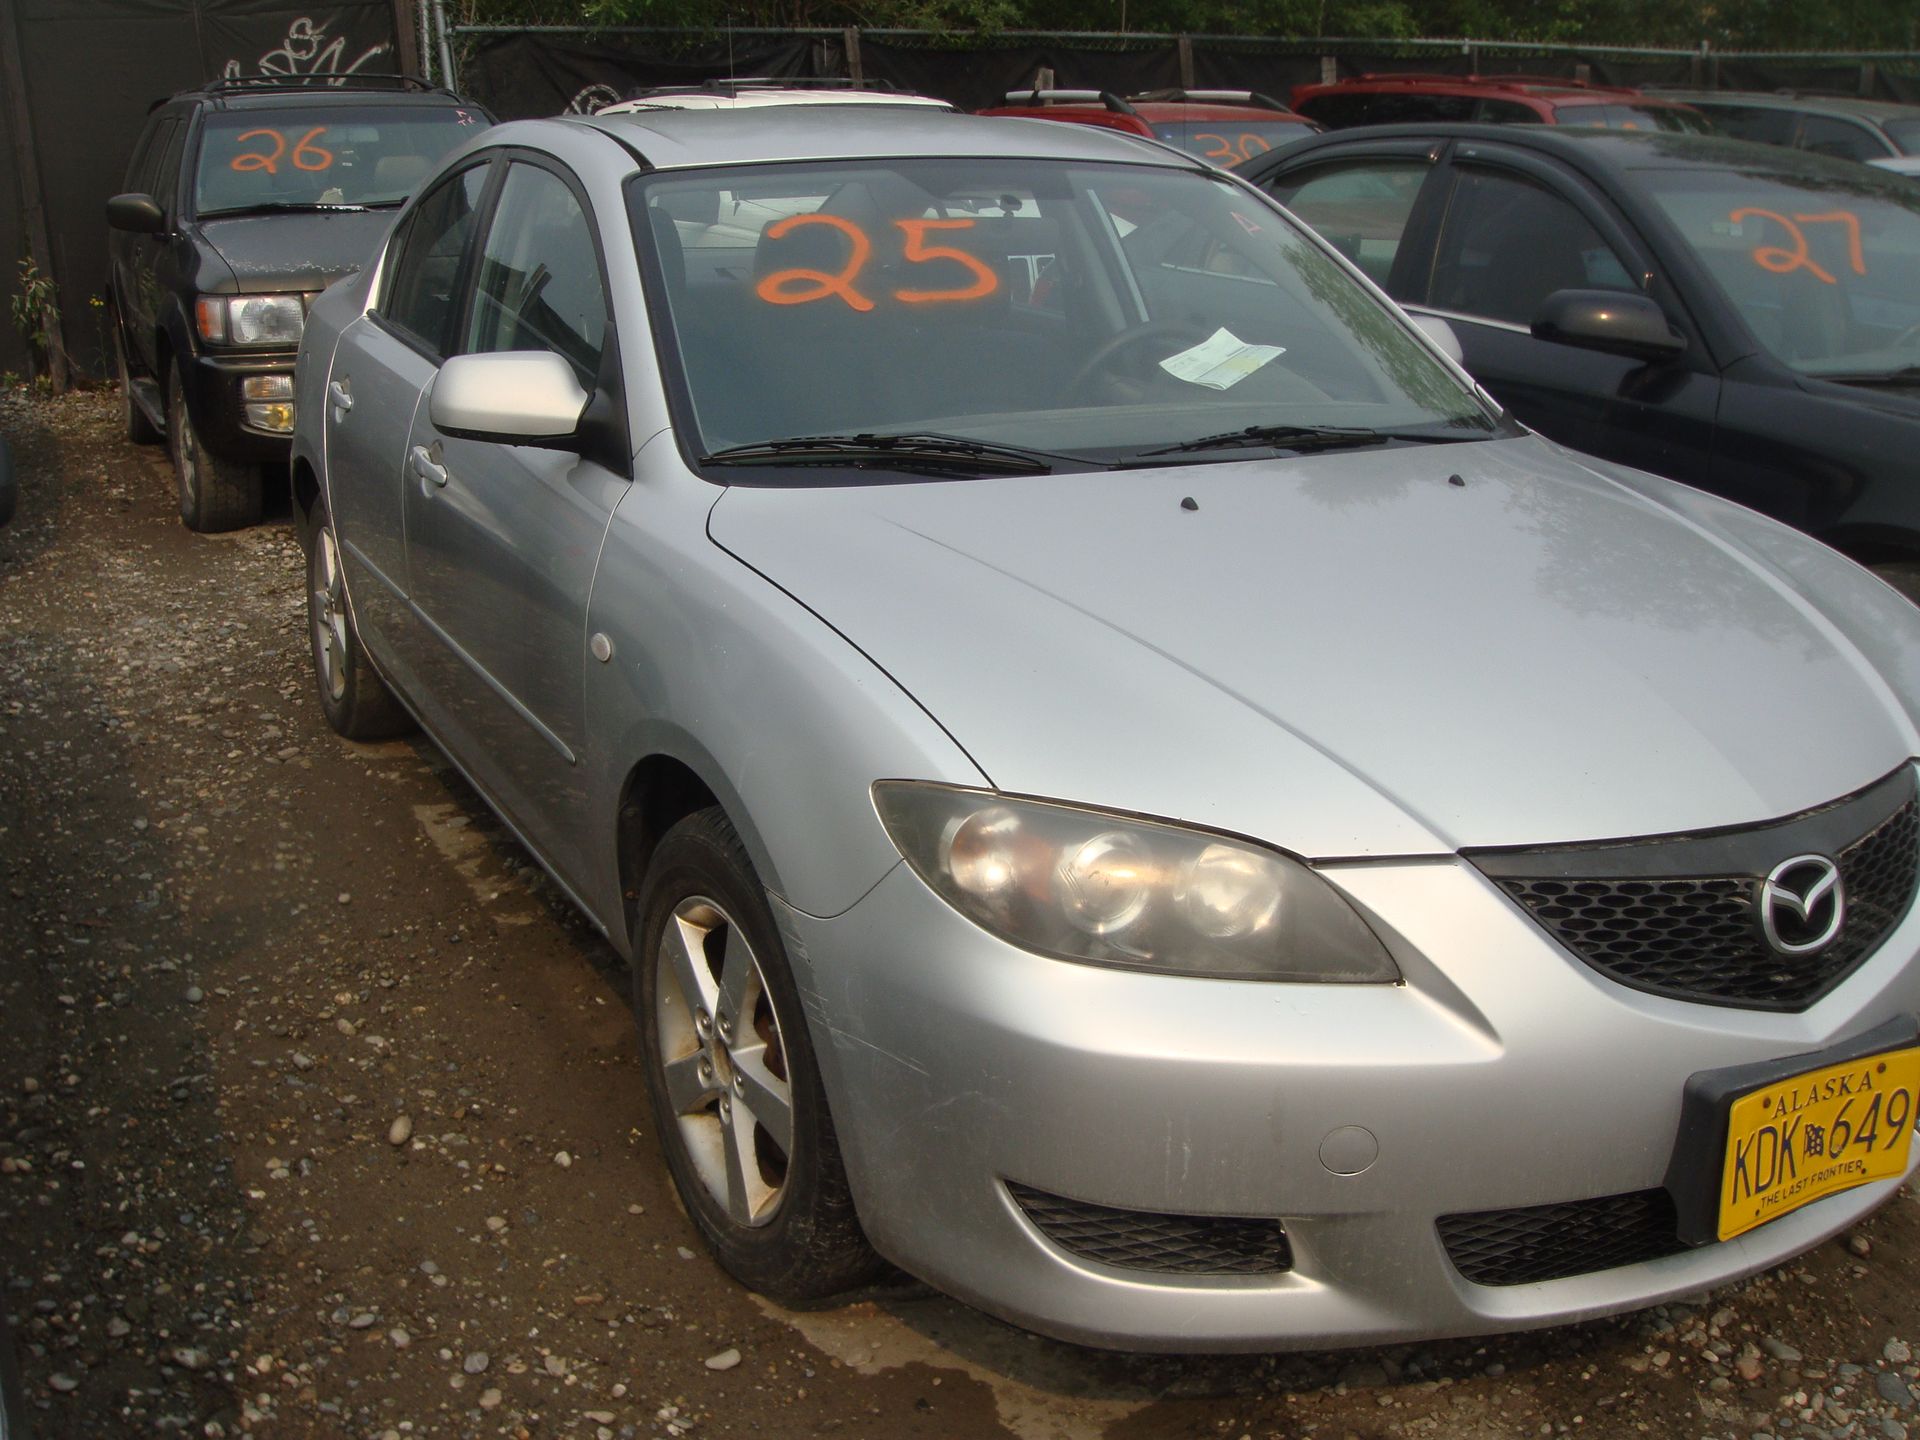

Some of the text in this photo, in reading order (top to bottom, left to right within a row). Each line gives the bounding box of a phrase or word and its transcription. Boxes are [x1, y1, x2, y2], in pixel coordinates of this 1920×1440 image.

[230, 126, 333, 174] 26
[1194, 133, 1270, 169] 30
[756, 213, 997, 312] 25
[1730, 207, 1866, 283] 27
[1771, 1071, 1872, 1119] ALASKA
[1732, 1087, 1910, 1205] KDK 649
[1761, 1160, 1862, 1209] THE LAST FRONTIER
